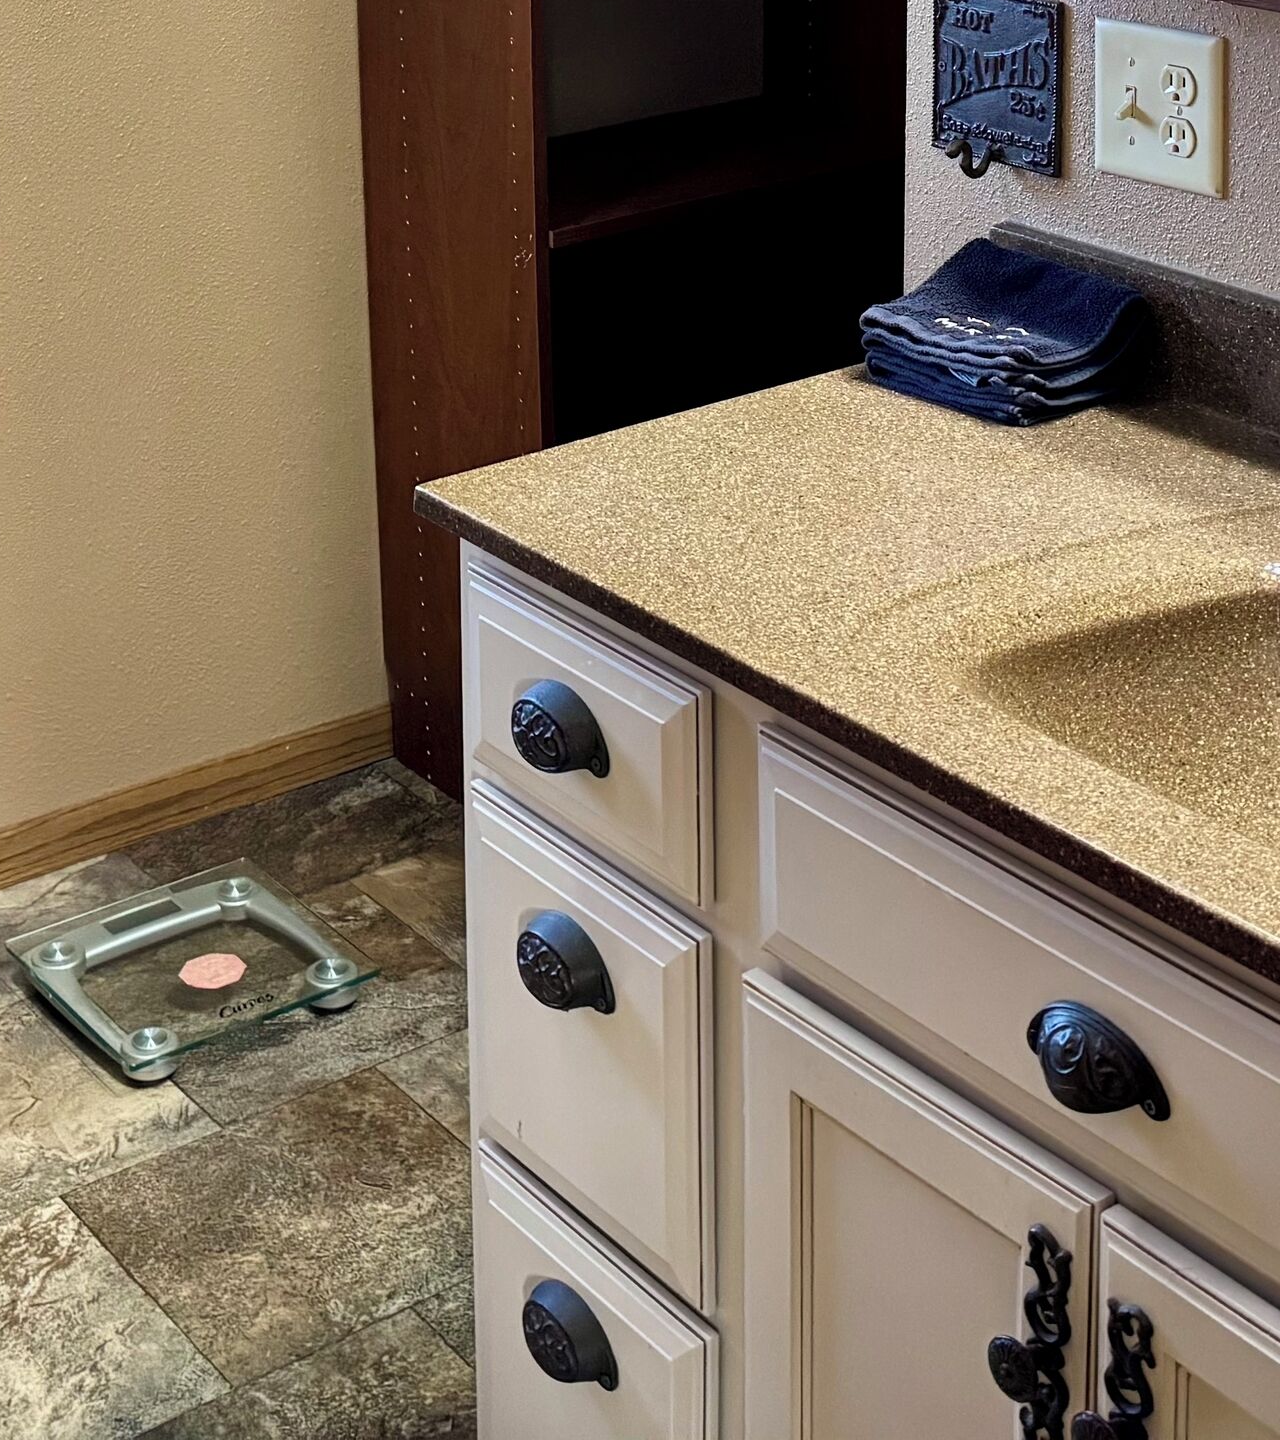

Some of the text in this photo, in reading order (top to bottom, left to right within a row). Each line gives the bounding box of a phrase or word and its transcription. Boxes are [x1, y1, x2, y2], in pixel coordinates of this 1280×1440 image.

[951, 5, 995, 34] HOT
[940, 34, 1051, 107] BATHS
[219, 993, 274, 1018] Curves
